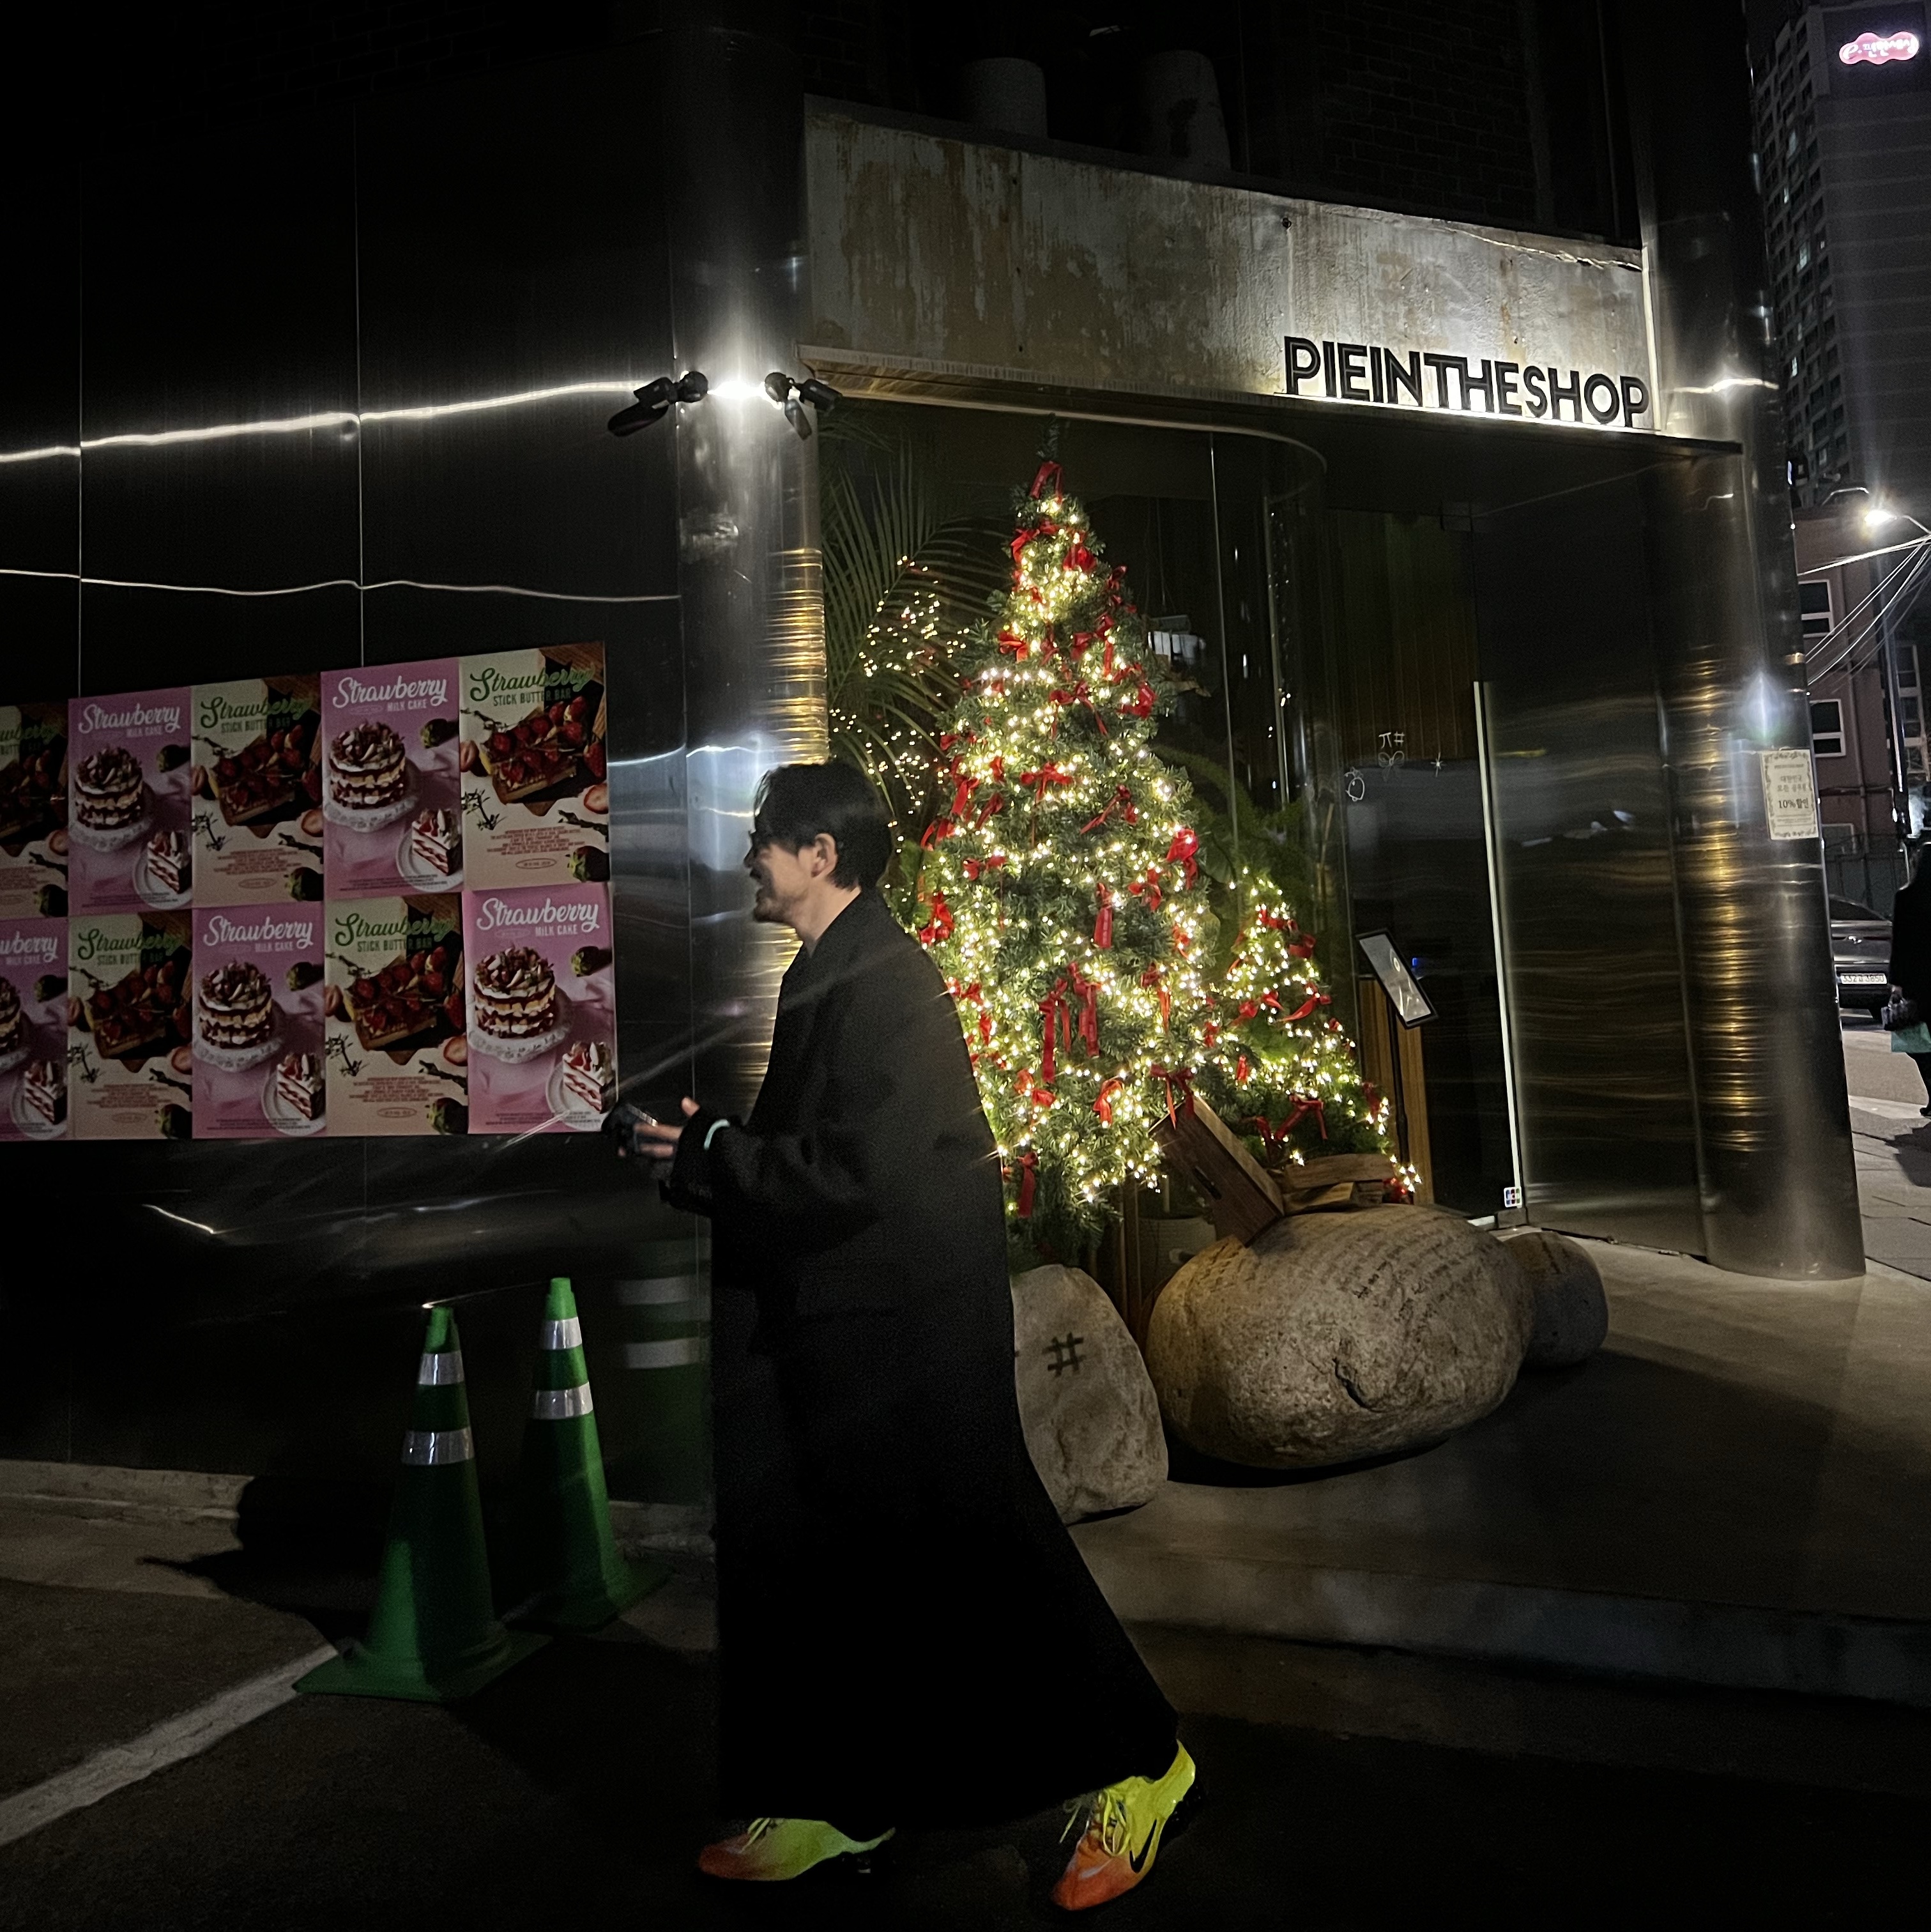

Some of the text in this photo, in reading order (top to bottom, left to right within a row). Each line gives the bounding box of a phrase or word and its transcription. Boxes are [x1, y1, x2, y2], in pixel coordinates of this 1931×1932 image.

[1283, 335, 1649, 428] PIEINTHESHOP
[333, 675, 448, 708] Strawberry
[469, 663, 595, 702] Strawberry
[493, 687, 571, 707] STICK BUTTER BAR
[78, 703, 181, 734] Strawberry
[201, 694, 313, 728] Strawberry
[387, 702, 406, 712] MILK
[408, 699, 427, 709] CAKE
[335, 913, 455, 946] Strawberry
[477, 897, 600, 933] Strawberry
[535, 926, 554, 937] MILK
[557, 924, 578, 935] CAKE
[78, 928, 183, 960] Strawberry
[203, 916, 314, 949] Strawberry
[357, 940, 381, 952] STICK
